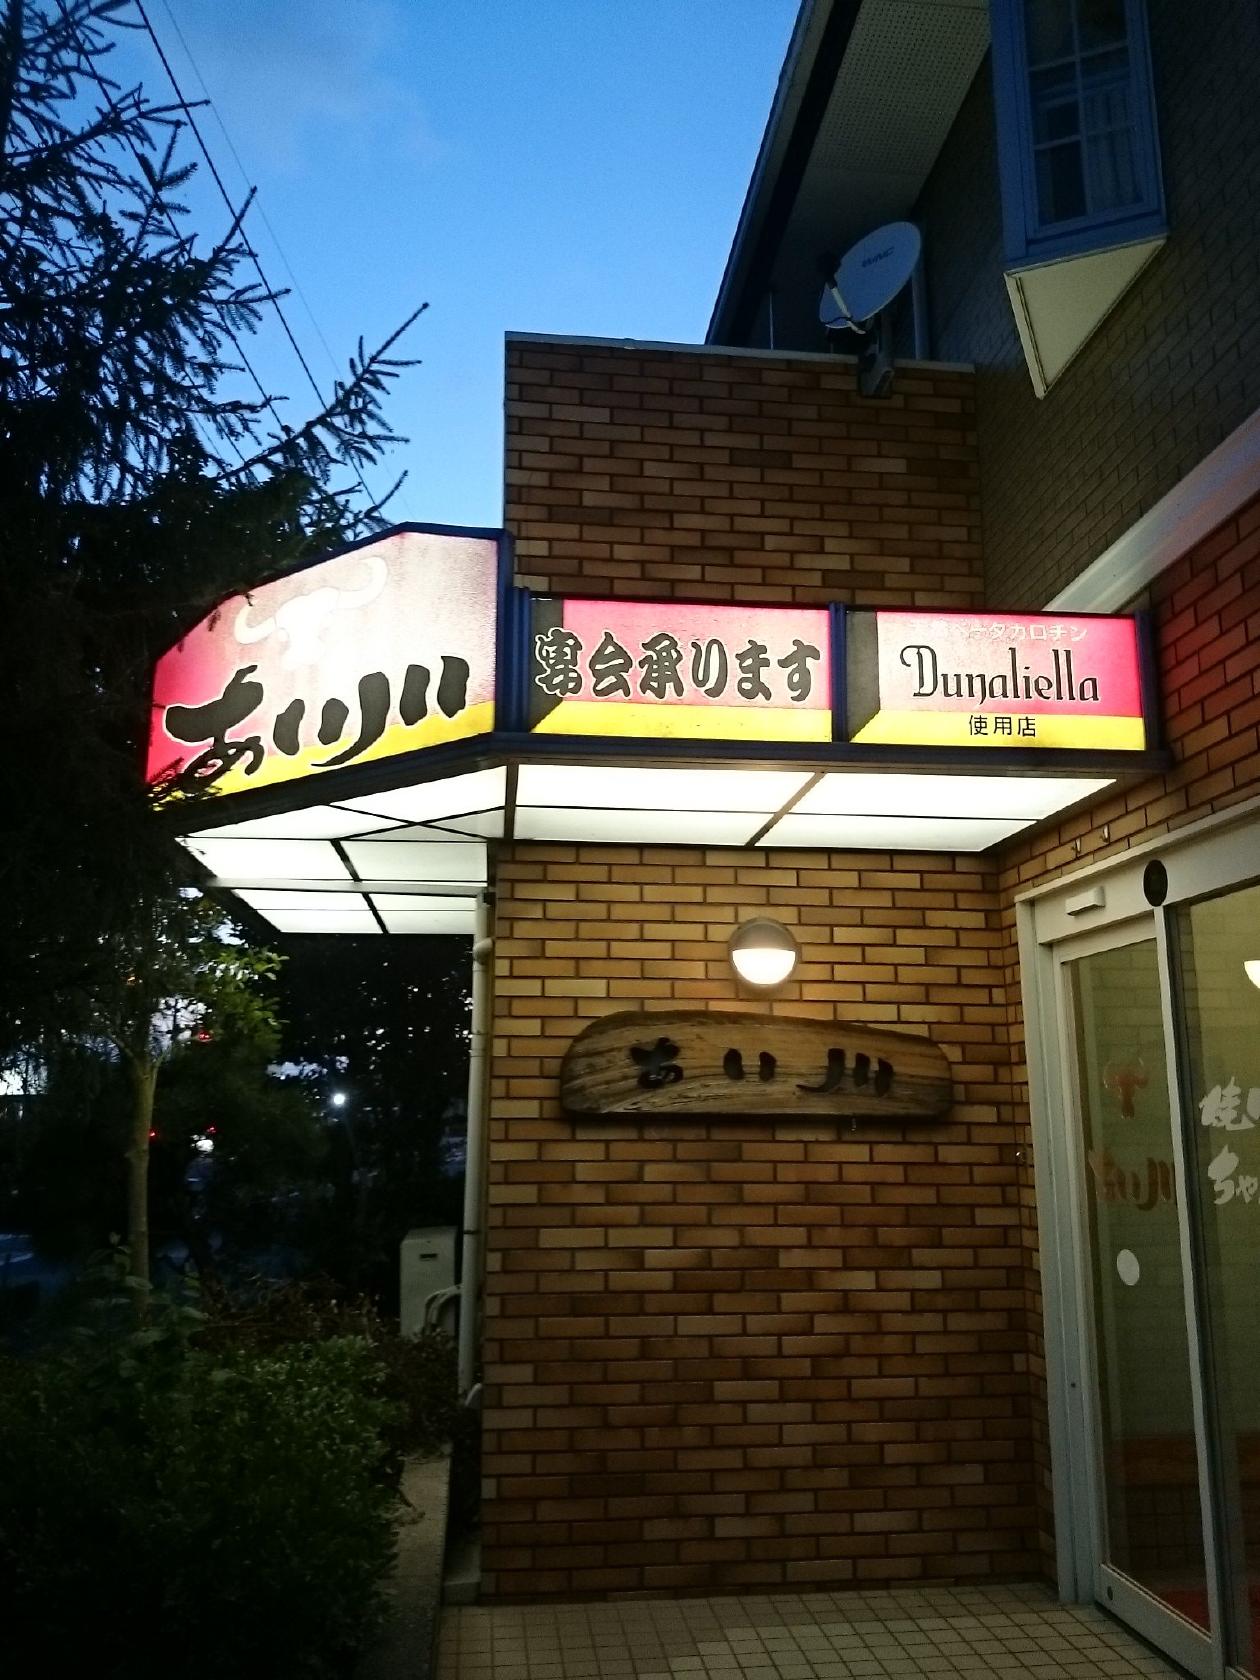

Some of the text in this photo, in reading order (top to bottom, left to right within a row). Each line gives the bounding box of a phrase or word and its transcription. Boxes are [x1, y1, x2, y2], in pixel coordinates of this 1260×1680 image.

[535, 627, 821, 702] 宴会承ります
[899, 644, 1100, 705] Dunaliella
[968, 714, 1036, 738] 使用店
